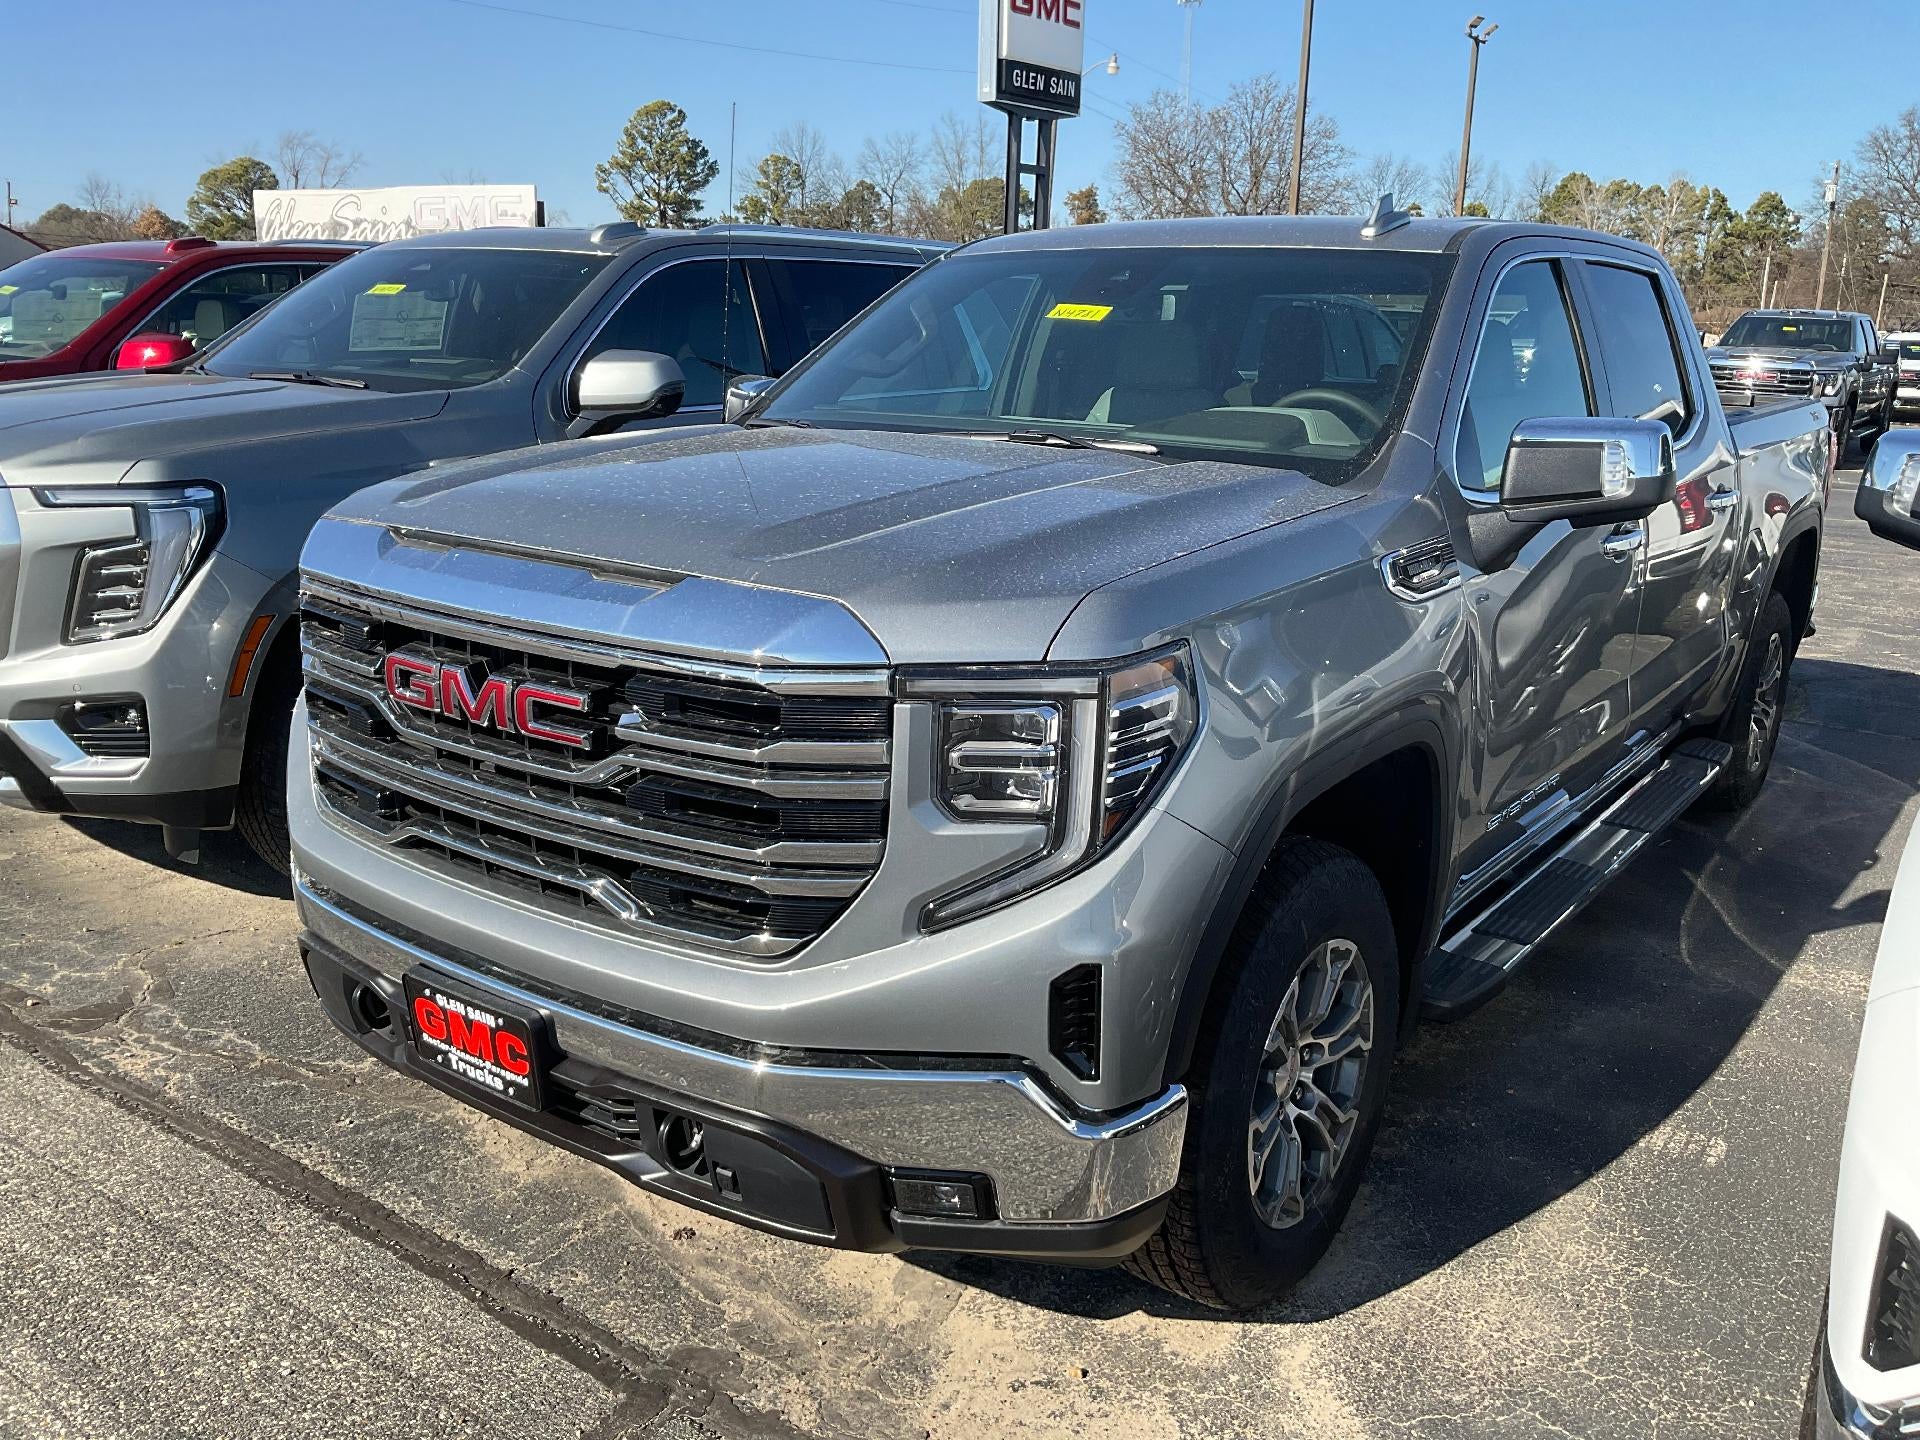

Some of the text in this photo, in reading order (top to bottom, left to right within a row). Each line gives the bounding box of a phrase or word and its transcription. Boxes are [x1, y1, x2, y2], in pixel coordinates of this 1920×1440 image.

[1010, 0, 1081, 30] GMC
[1013, 69, 1075, 97] GLEN SAIN
[413, 195, 523, 230] GMC
[384, 651, 592, 751] GMC
[435, 993, 496, 1028] GLEN SAIN
[414, 997, 530, 1076] GMC
[448, 1052, 504, 1091] Trucks
